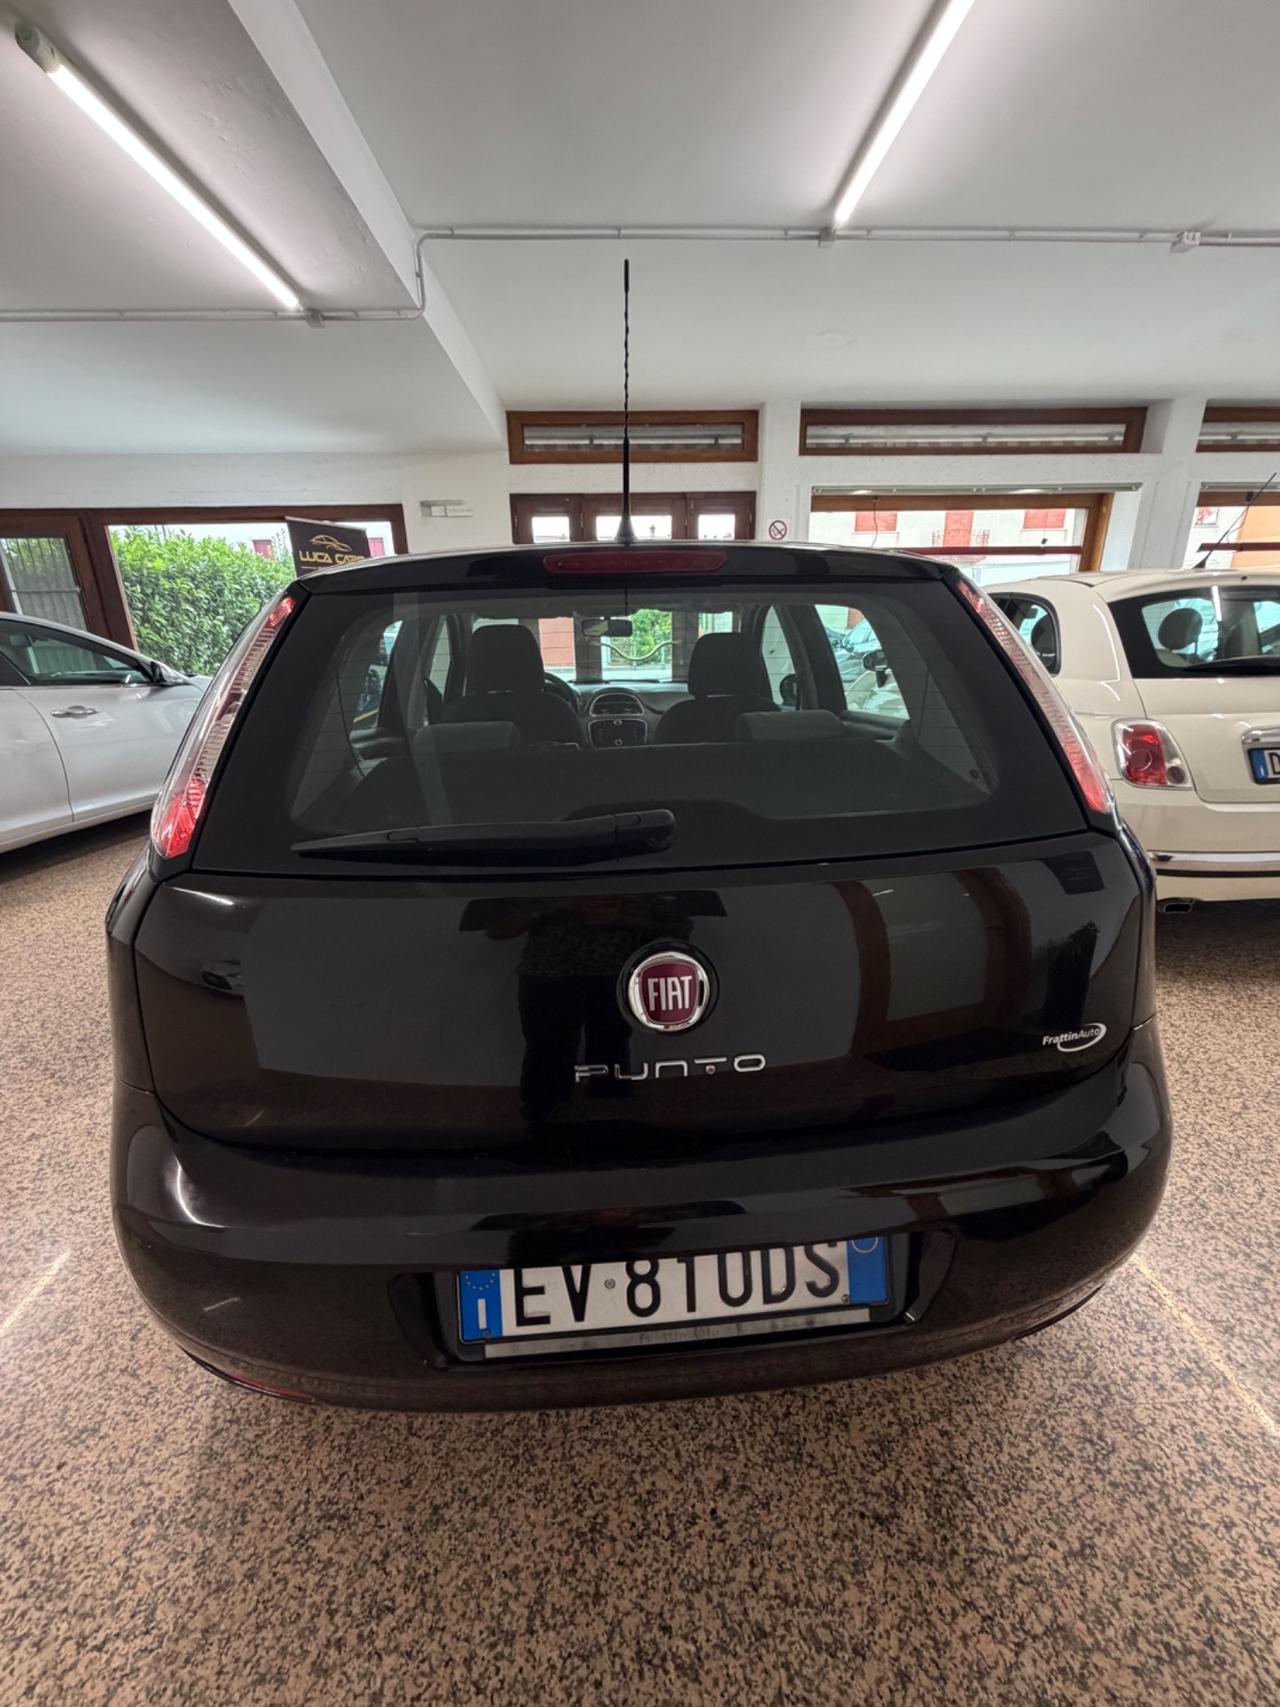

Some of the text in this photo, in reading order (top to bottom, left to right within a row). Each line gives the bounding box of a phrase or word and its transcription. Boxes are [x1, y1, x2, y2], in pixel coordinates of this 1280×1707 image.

[299, 550, 333, 564] LUCA
[647, 975, 693, 1012] FIAT
[1042, 1028, 1101, 1046] FrattinAuto
[574, 1053, 767, 1083] PUNTO
[513, 1263, 592, 1327] EV
